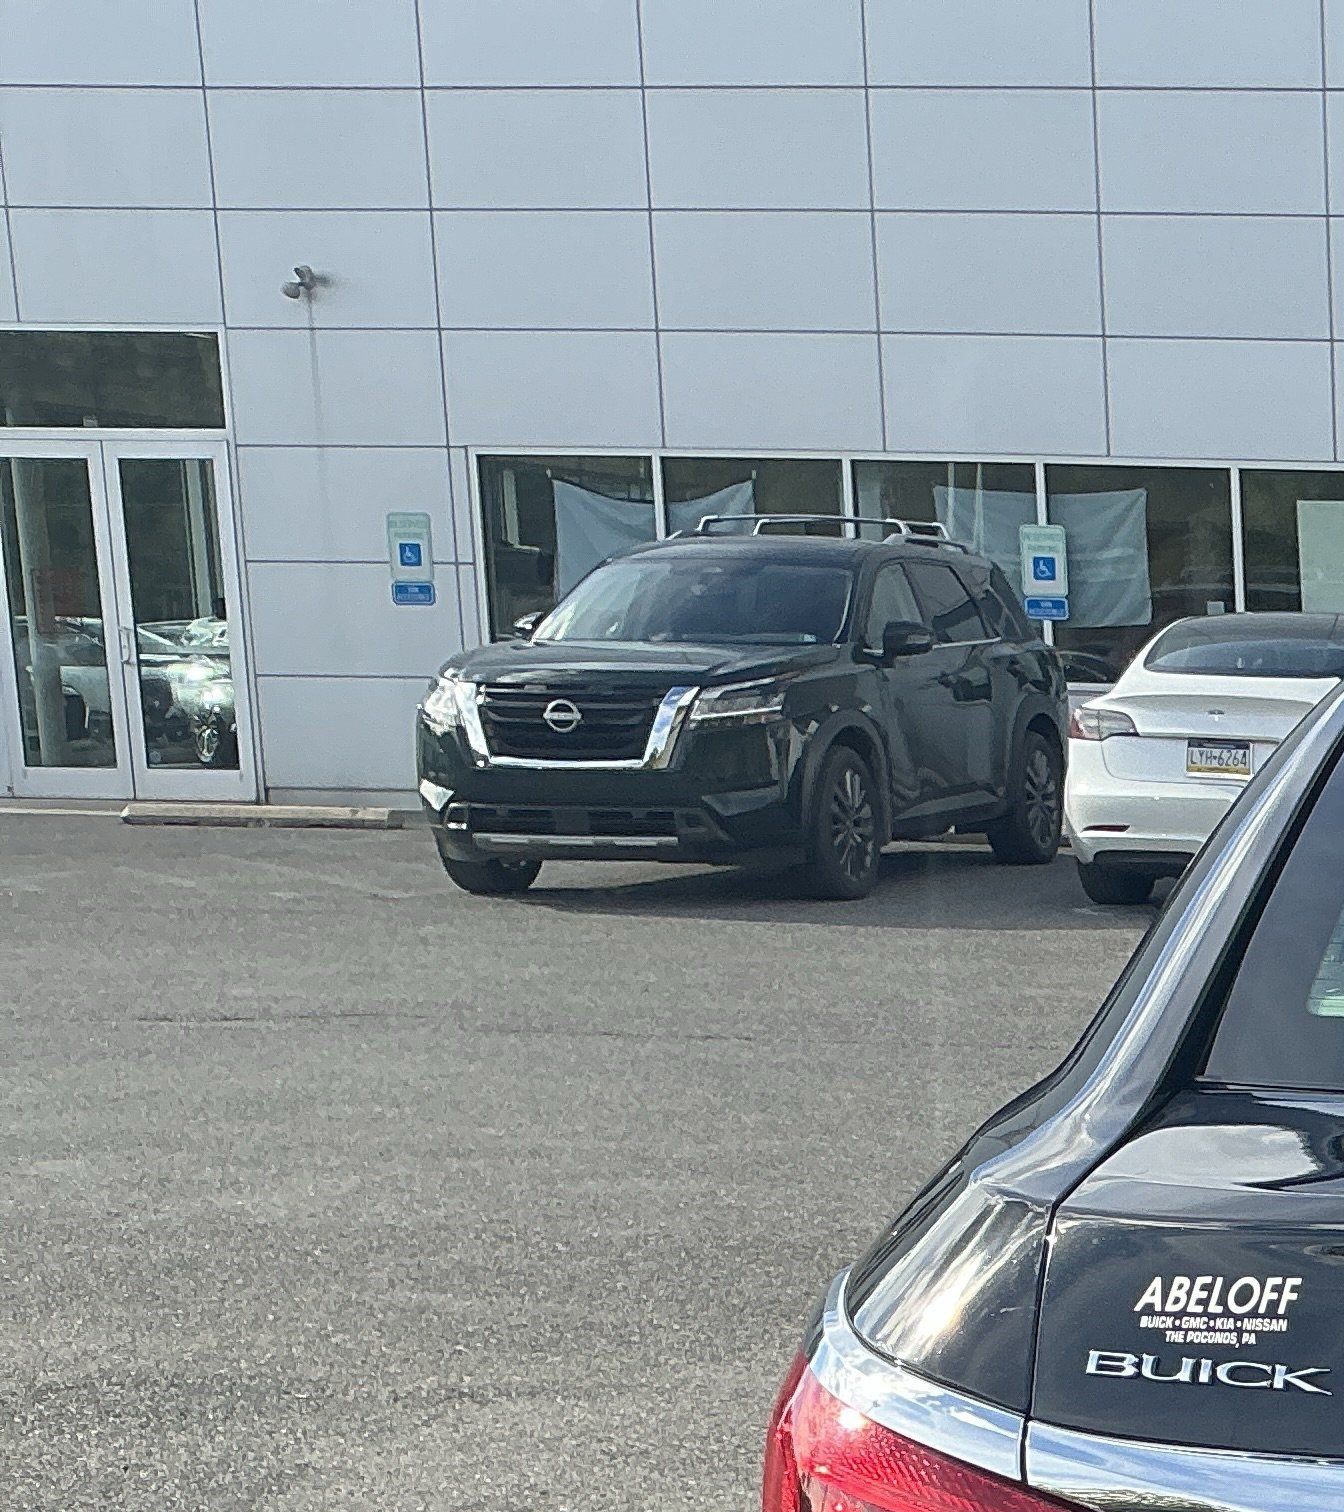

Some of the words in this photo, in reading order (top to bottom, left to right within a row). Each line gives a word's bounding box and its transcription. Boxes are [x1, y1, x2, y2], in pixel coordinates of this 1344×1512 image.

[1133, 1275, 1302, 1315] ABELOFF
[1139, 1315, 1174, 1329] BUICK
[1181, 1316, 1208, 1329] GMC
[1215, 1317, 1234, 1330] KIA
[1243, 1317, 1288, 1331] NISSAN
[1165, 1330, 1184, 1343] THE
[1186, 1331, 1239, 1348] POCONOS,
[1241, 1333, 1256, 1345] PA
[1085, 1348, 1333, 1396] BUICK
